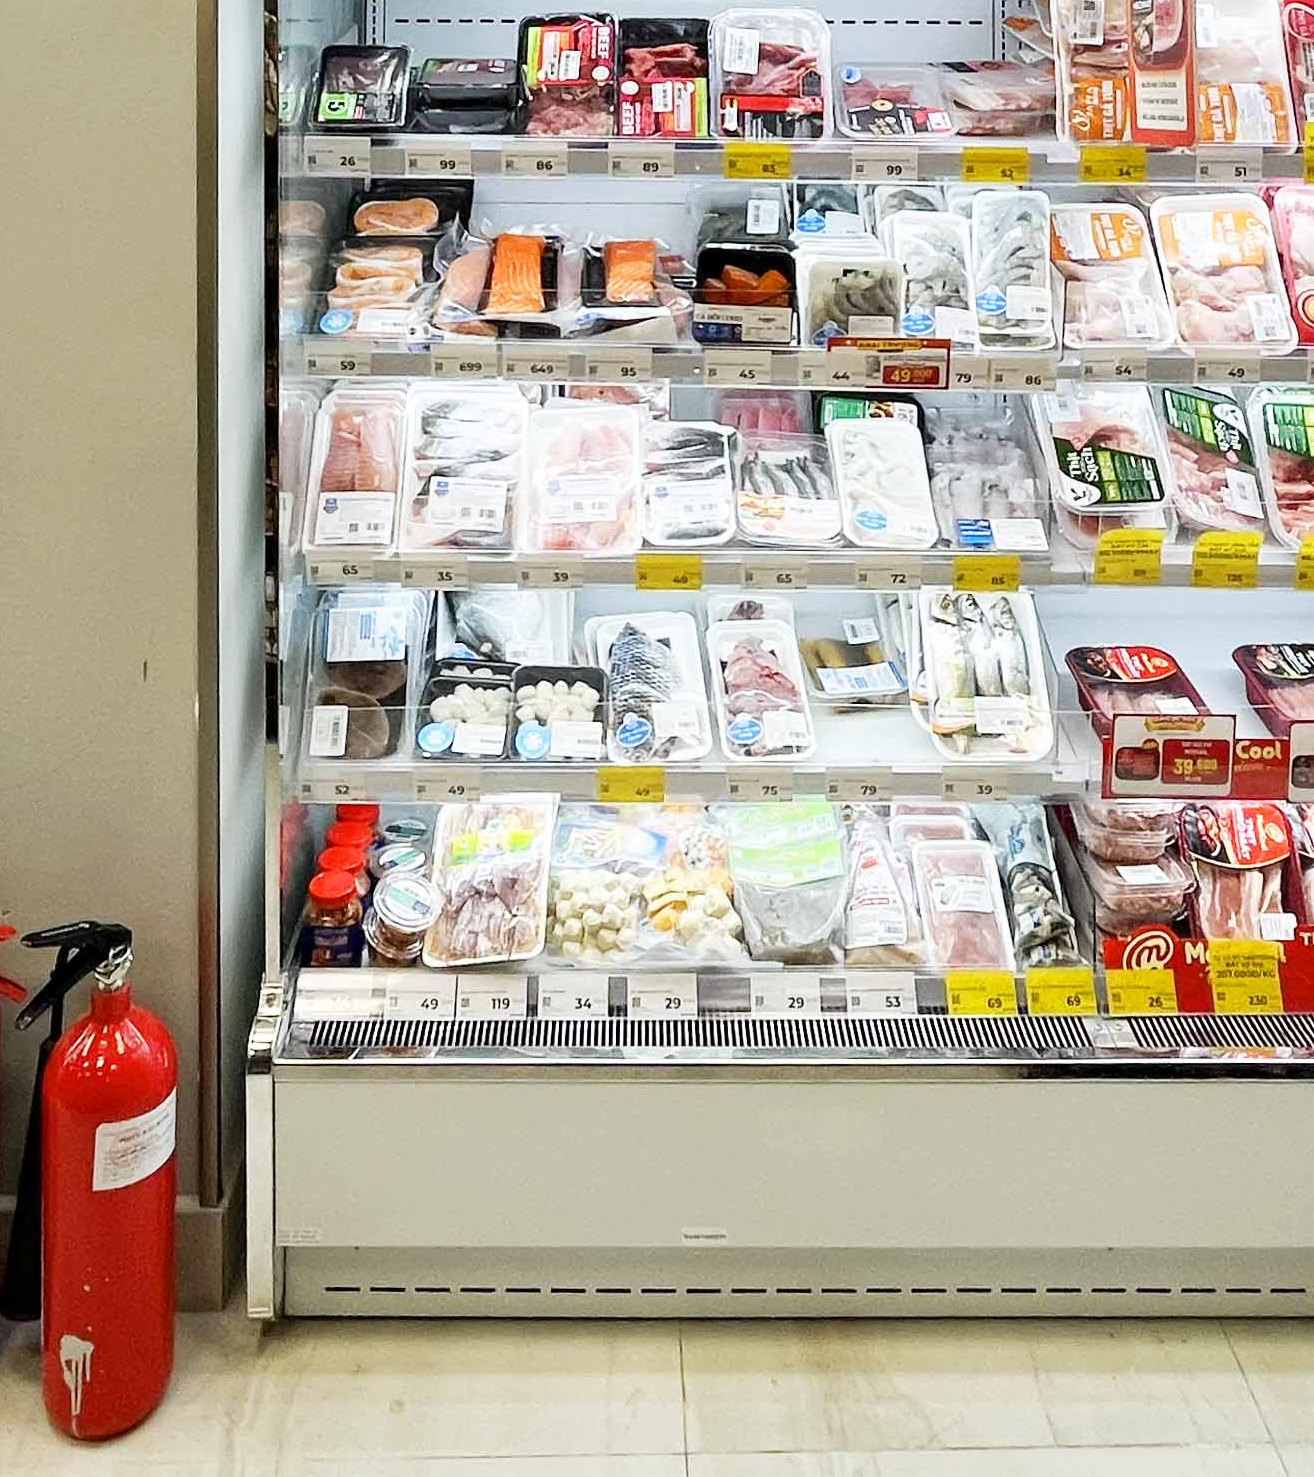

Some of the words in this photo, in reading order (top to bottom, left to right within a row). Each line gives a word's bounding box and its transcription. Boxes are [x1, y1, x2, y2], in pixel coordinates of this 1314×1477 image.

[598, 26, 609, 59] BEEF
[339, 155, 356, 167] 26
[439, 159, 457, 170] 99
[536, 159, 553, 171] 86
[886, 164, 902, 175] 99
[340, 360, 356, 371] 59
[620, 366, 637, 378] 95
[832, 371, 850, 381] 44
[956, 372, 972, 383] 79
[1228, 367, 1245, 378] 49
[1025, 374, 1041, 386] 86
[342, 564, 359, 575] 65
[436, 571, 453, 582] 35
[776, 573, 792, 584] 65
[1235, 740, 1283, 761] Cool
[335, 785, 350, 795] 52
[448, 785, 465, 796] 49
[761, 785, 778, 796] 75
[976, 785, 993, 795] 39
[491, 998, 510, 1009] 119
[575, 998, 592, 1010] 34
[665, 997, 681, 1009] 29
[885, 996, 901, 1008] 53
[1067, 994, 1081, 1007] 69
[1148, 995, 1162, 1007] 26
